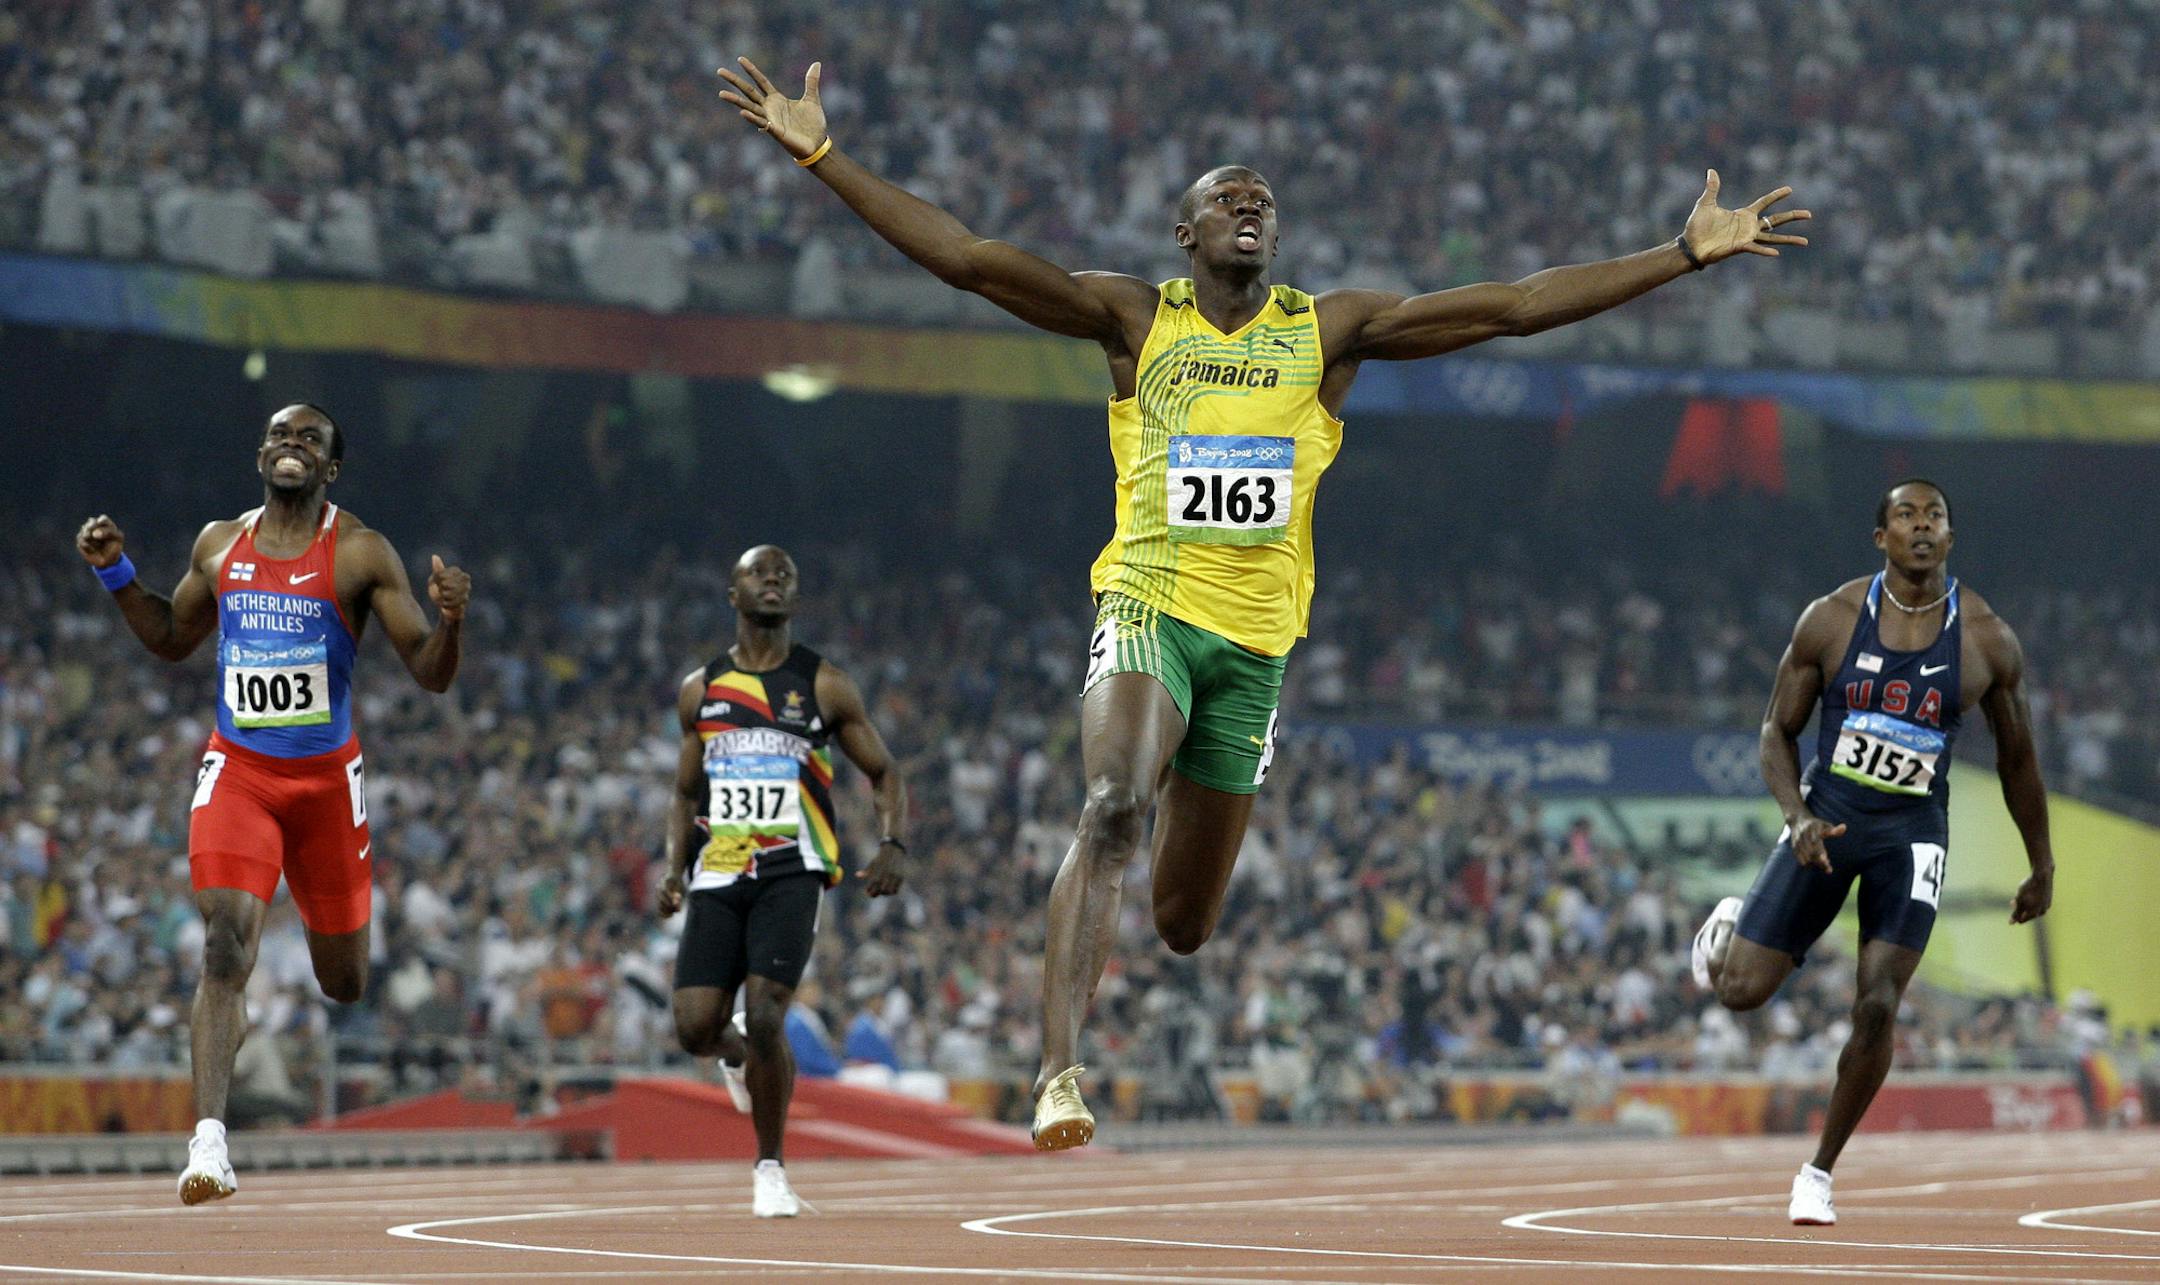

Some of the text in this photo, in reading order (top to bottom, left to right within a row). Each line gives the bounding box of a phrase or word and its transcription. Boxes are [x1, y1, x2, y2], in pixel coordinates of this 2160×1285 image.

[1170, 352, 1280, 388] jamaica
[1195, 447, 1253, 460] Beijing 2008
[1182, 474, 1276, 524] 2163
[226, 592, 322, 618] NETHERLANDS
[240, 613, 305, 634] ANTILLES
[236, 672, 314, 713] 1003
[1845, 679, 1942, 728] USA
[1846, 735, 1924, 786] 3152
[721, 785, 785, 820] 3317
